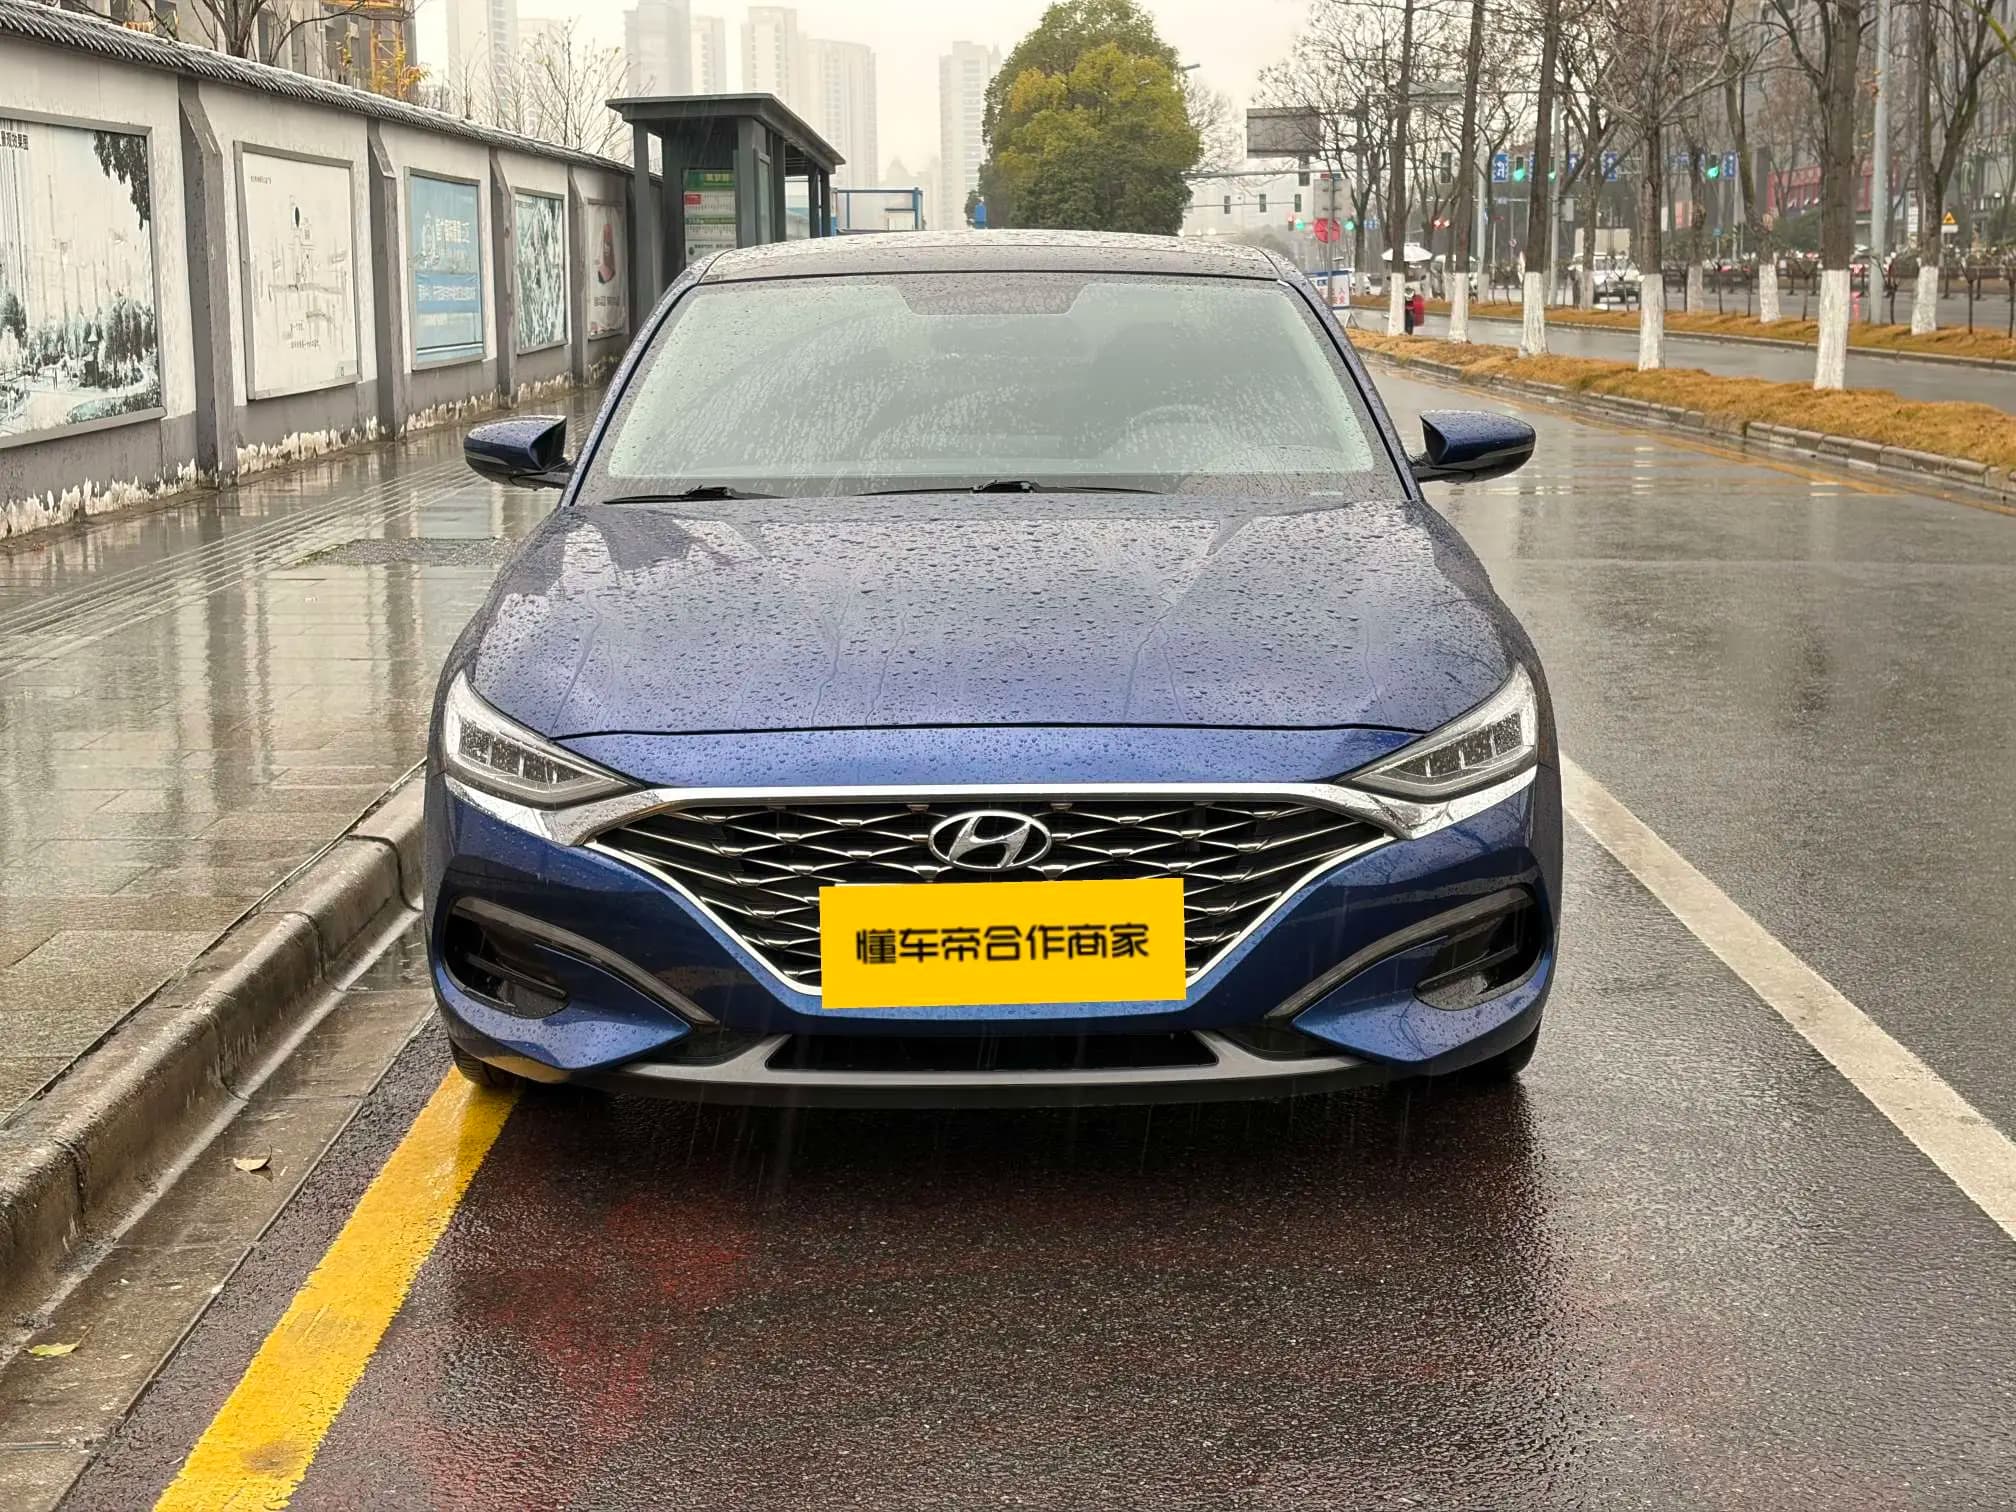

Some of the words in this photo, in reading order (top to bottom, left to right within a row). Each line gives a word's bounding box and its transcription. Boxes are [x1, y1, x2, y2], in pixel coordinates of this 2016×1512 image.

[0, 131, 29, 150] 景观效果图
